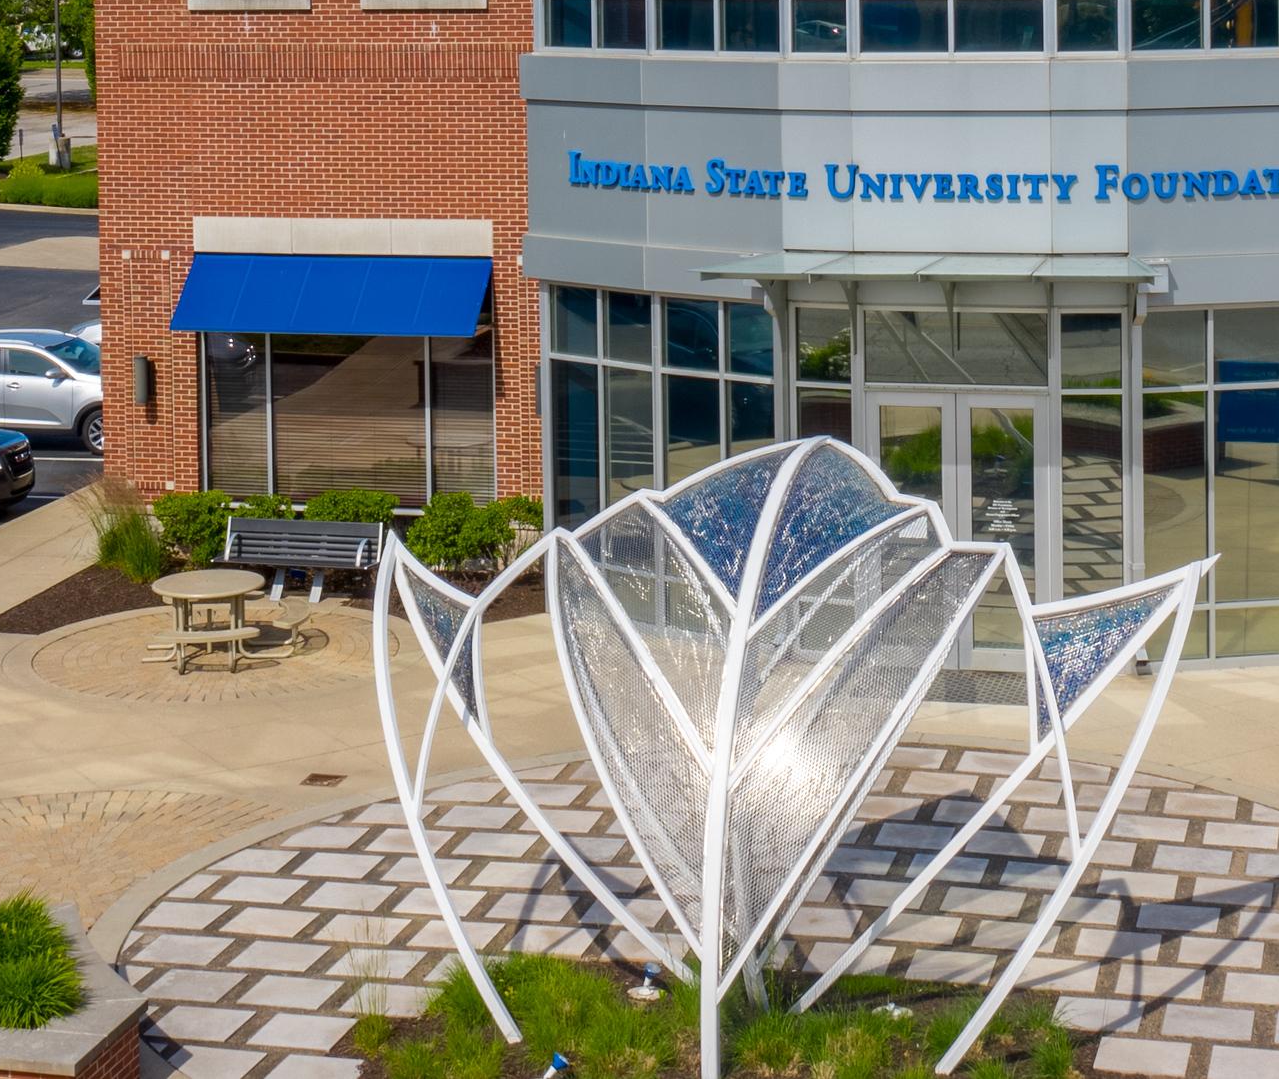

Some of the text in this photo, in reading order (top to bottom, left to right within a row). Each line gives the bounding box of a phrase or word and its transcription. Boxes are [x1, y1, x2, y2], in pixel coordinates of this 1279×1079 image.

[567, 150, 695, 193] INDIANA
[705, 157, 808, 198] STATE
[824, 164, 1078, 201] UNIVERSITY
